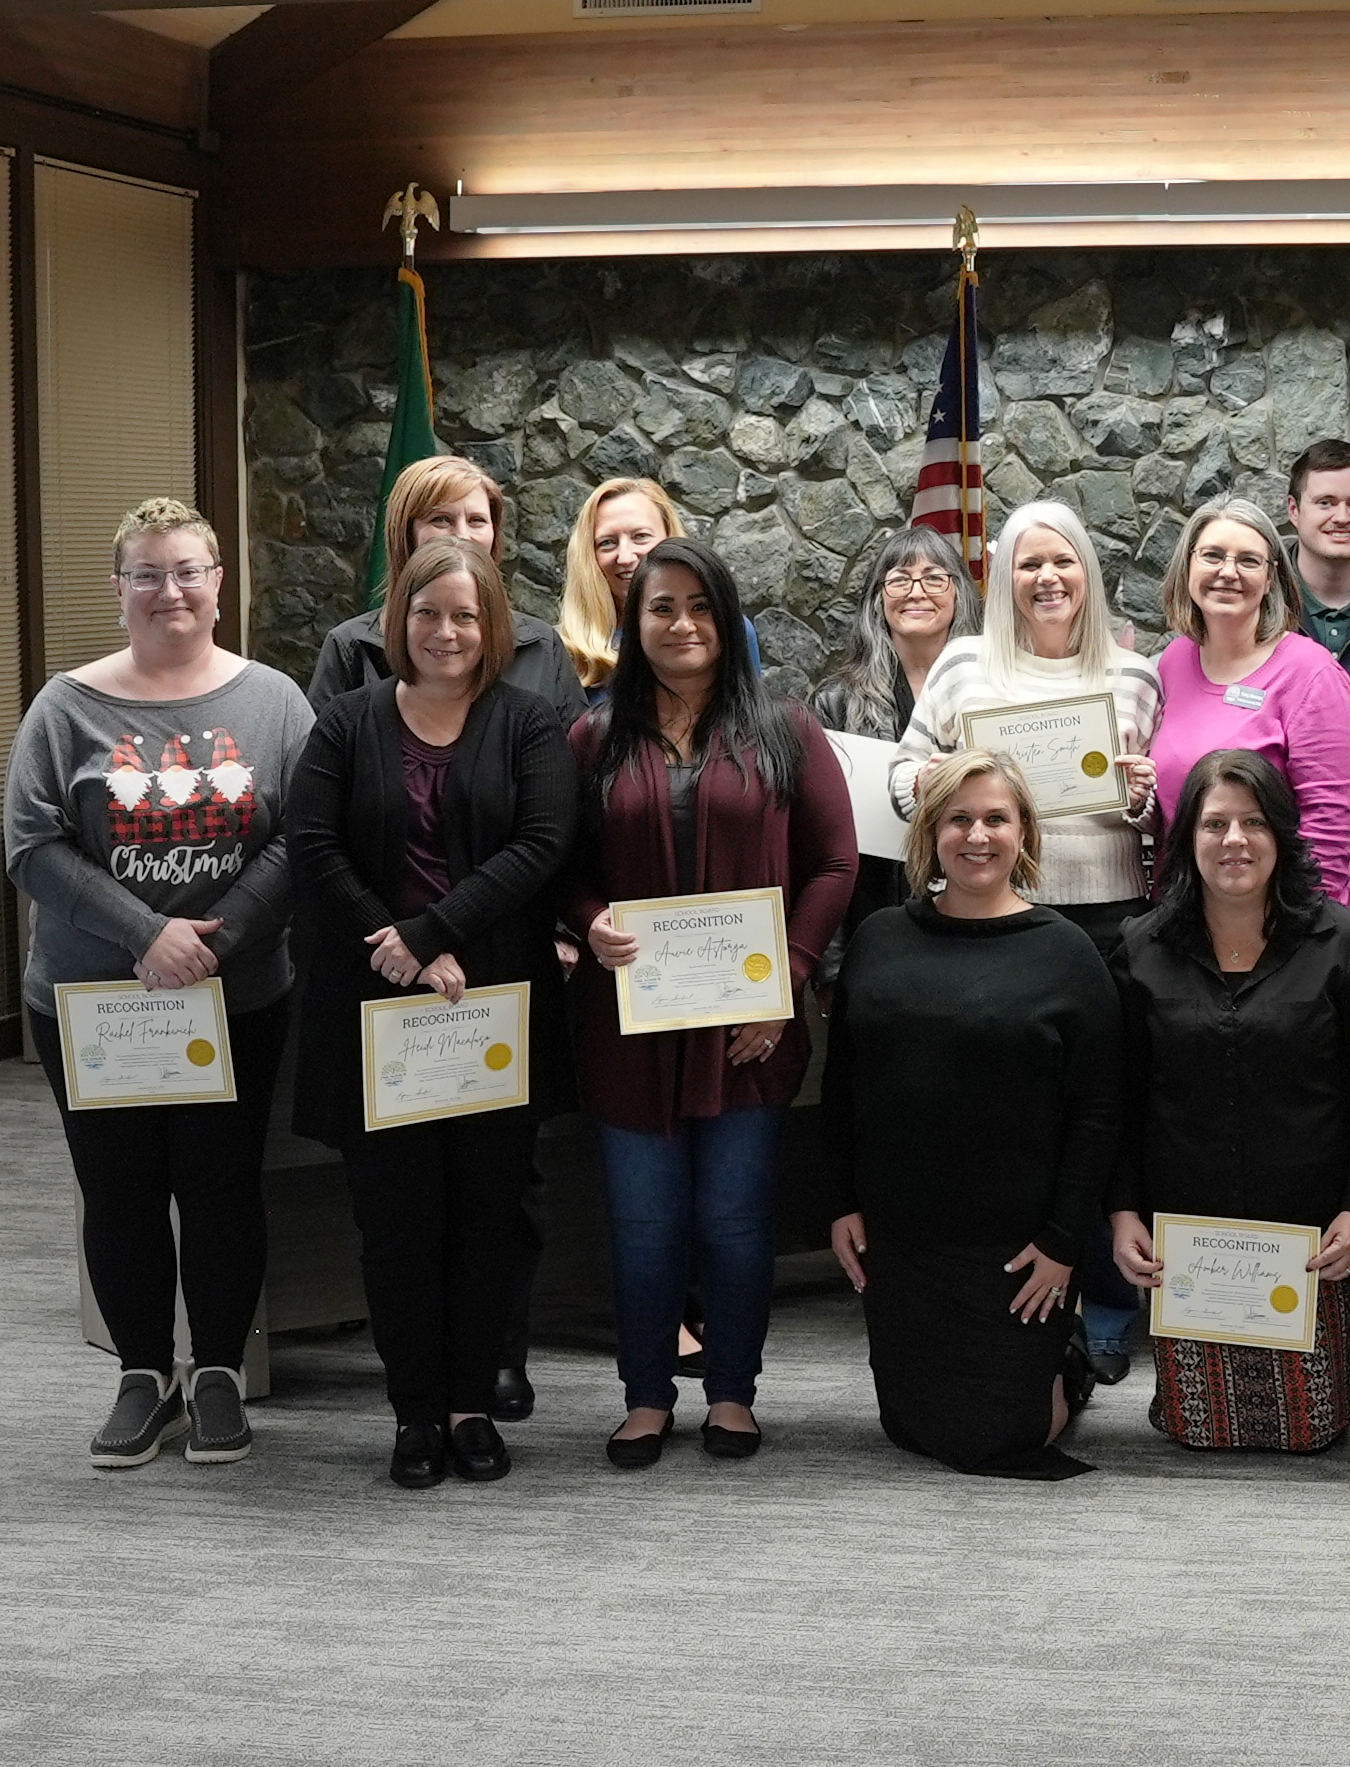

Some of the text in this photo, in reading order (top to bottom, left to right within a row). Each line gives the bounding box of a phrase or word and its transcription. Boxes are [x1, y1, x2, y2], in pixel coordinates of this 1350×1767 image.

[998, 715, 1082, 737] RECOGNITION
[1046, 735, 1083, 762] Smith
[106, 803, 259, 845] MERRY
[110, 839, 246, 885] Christmas
[653, 914, 744, 933] RECOGNITION
[97, 1000, 185, 1014] RECOGNITION
[402, 1008, 491, 1029] RECOGNITION
[95, 1021, 135, 1047] Rachel
[397, 1036, 435, 1062] Heidi
[1192, 1236, 1281, 1254] RECOGNITION
[1187, 1255, 1282, 1284] Amber Williams
